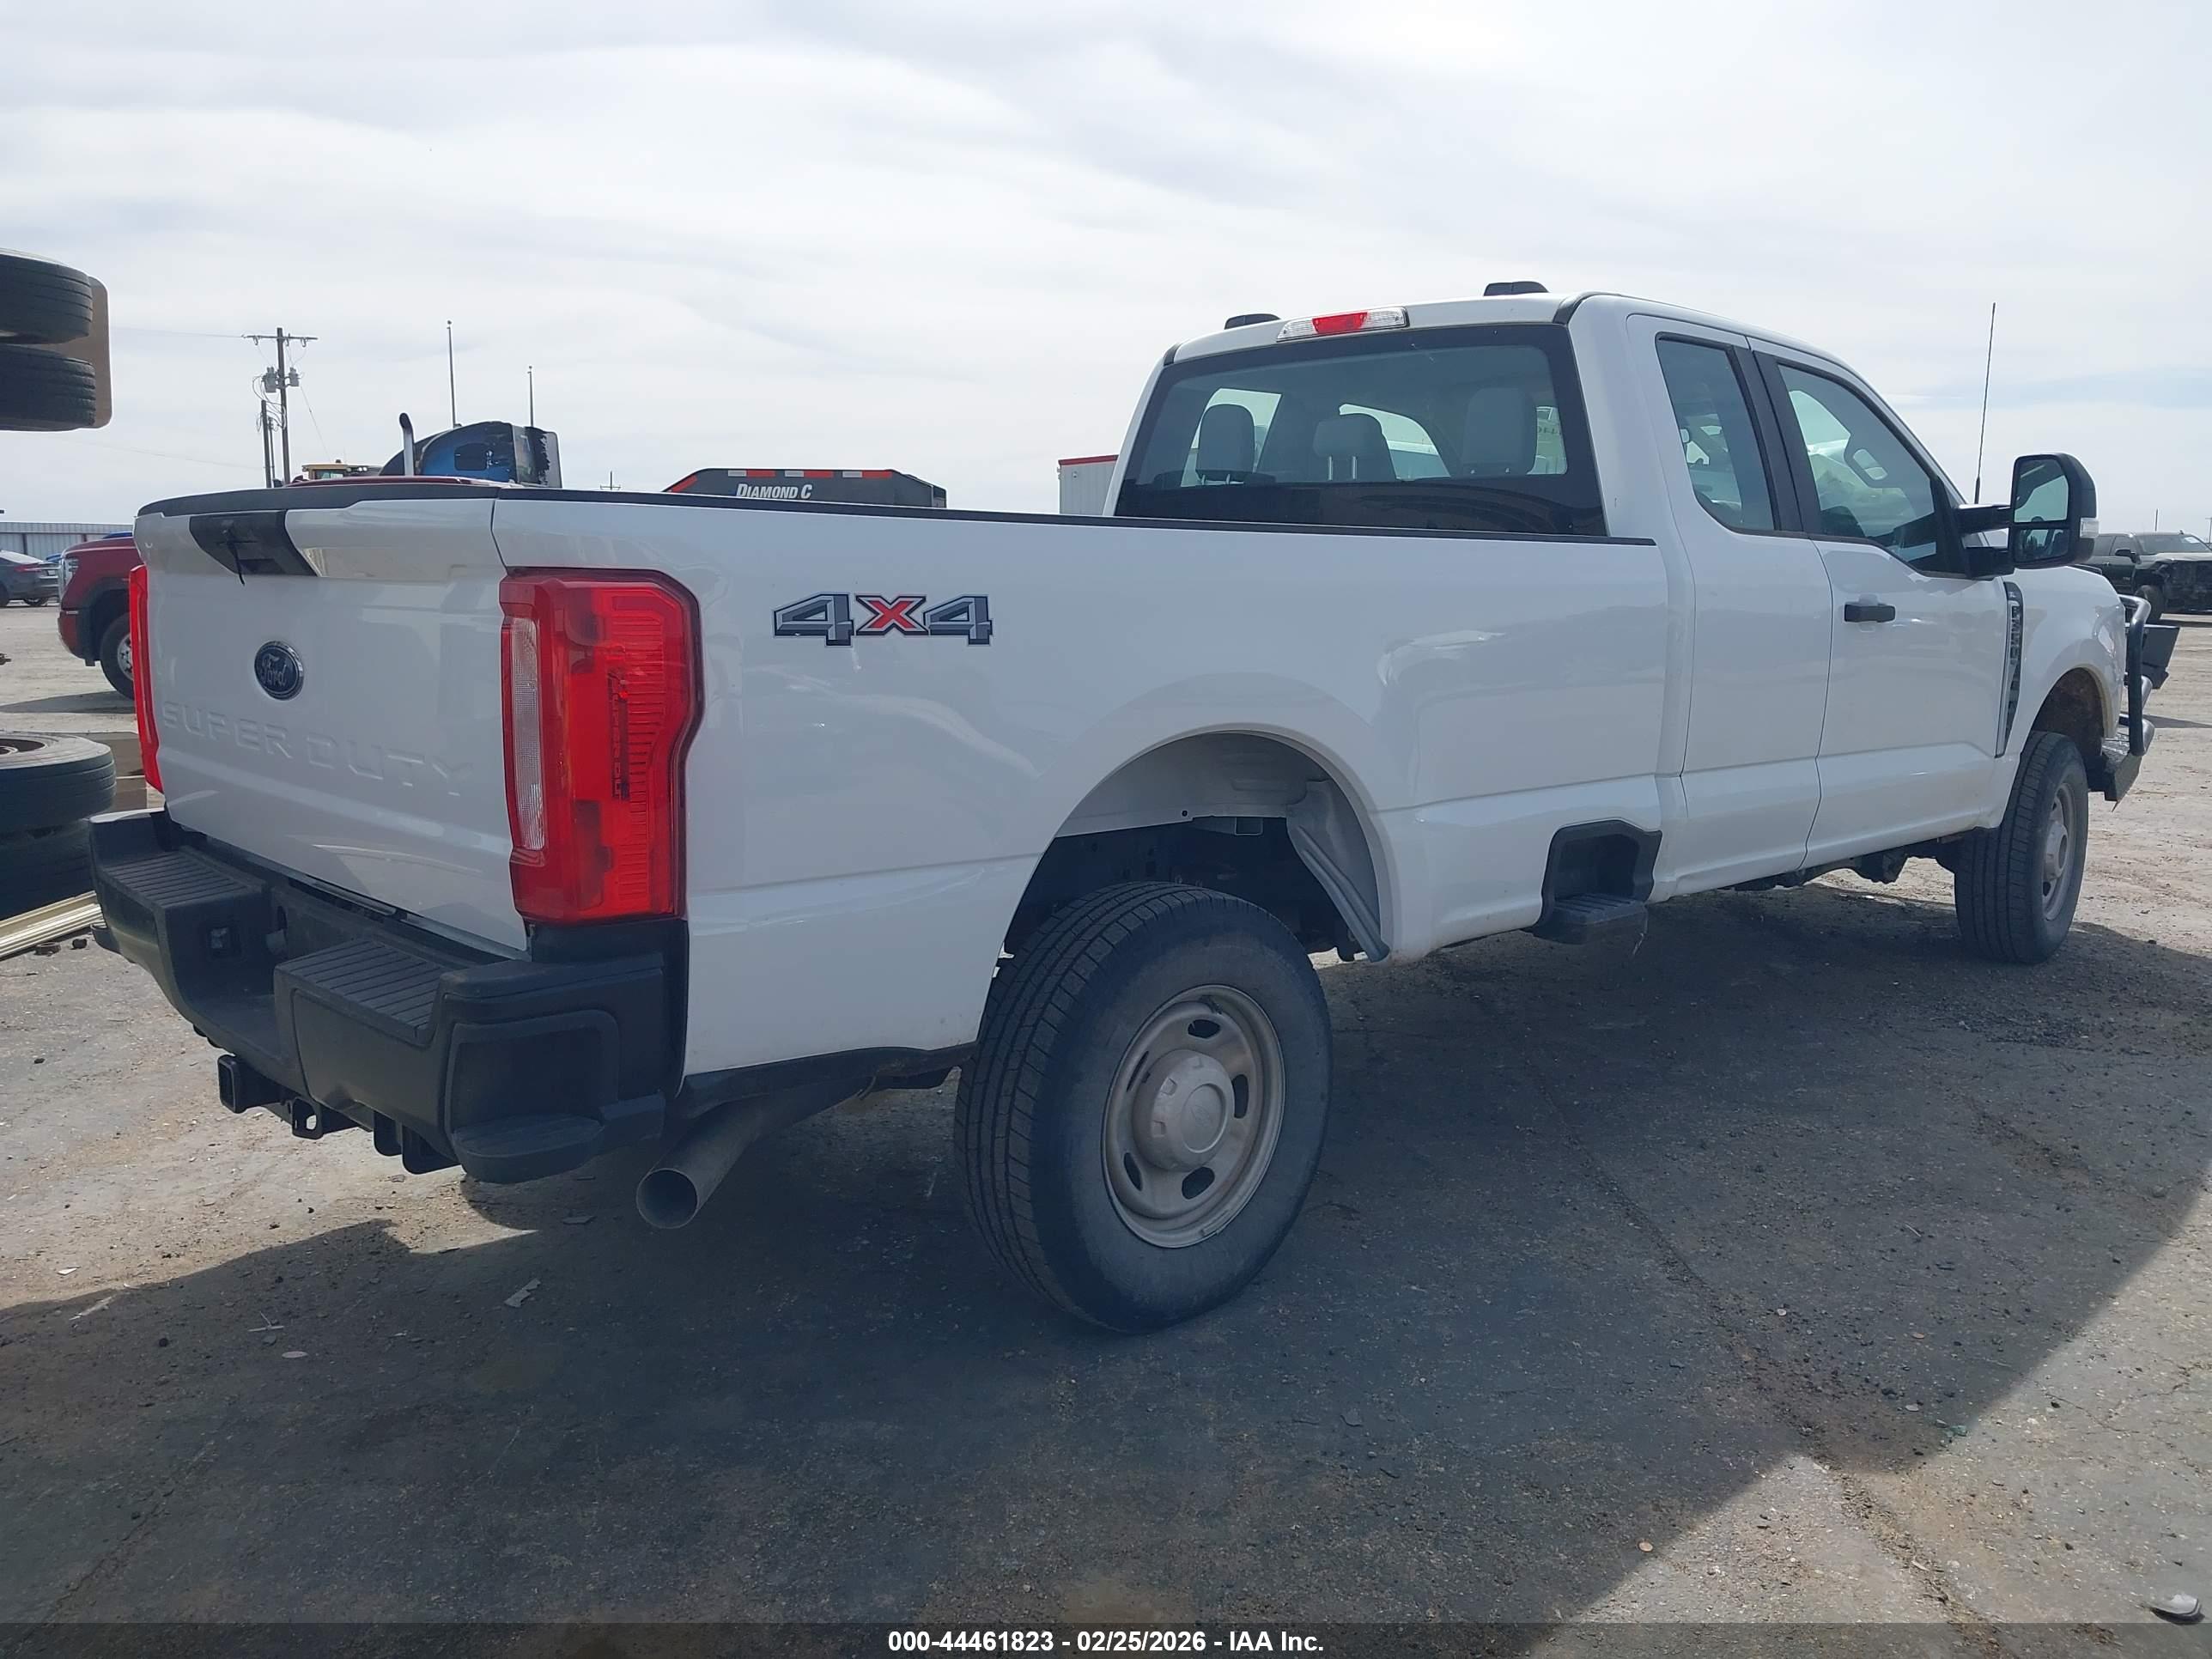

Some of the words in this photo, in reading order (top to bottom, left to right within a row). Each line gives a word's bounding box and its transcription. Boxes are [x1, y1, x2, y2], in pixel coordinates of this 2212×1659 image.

[736, 483, 799, 499] DIAMOND
[800, 483, 813, 499] C
[259, 652, 291, 688] Ford
[161, 701, 293, 758] SUPER
[306, 732, 473, 797] DUTY
